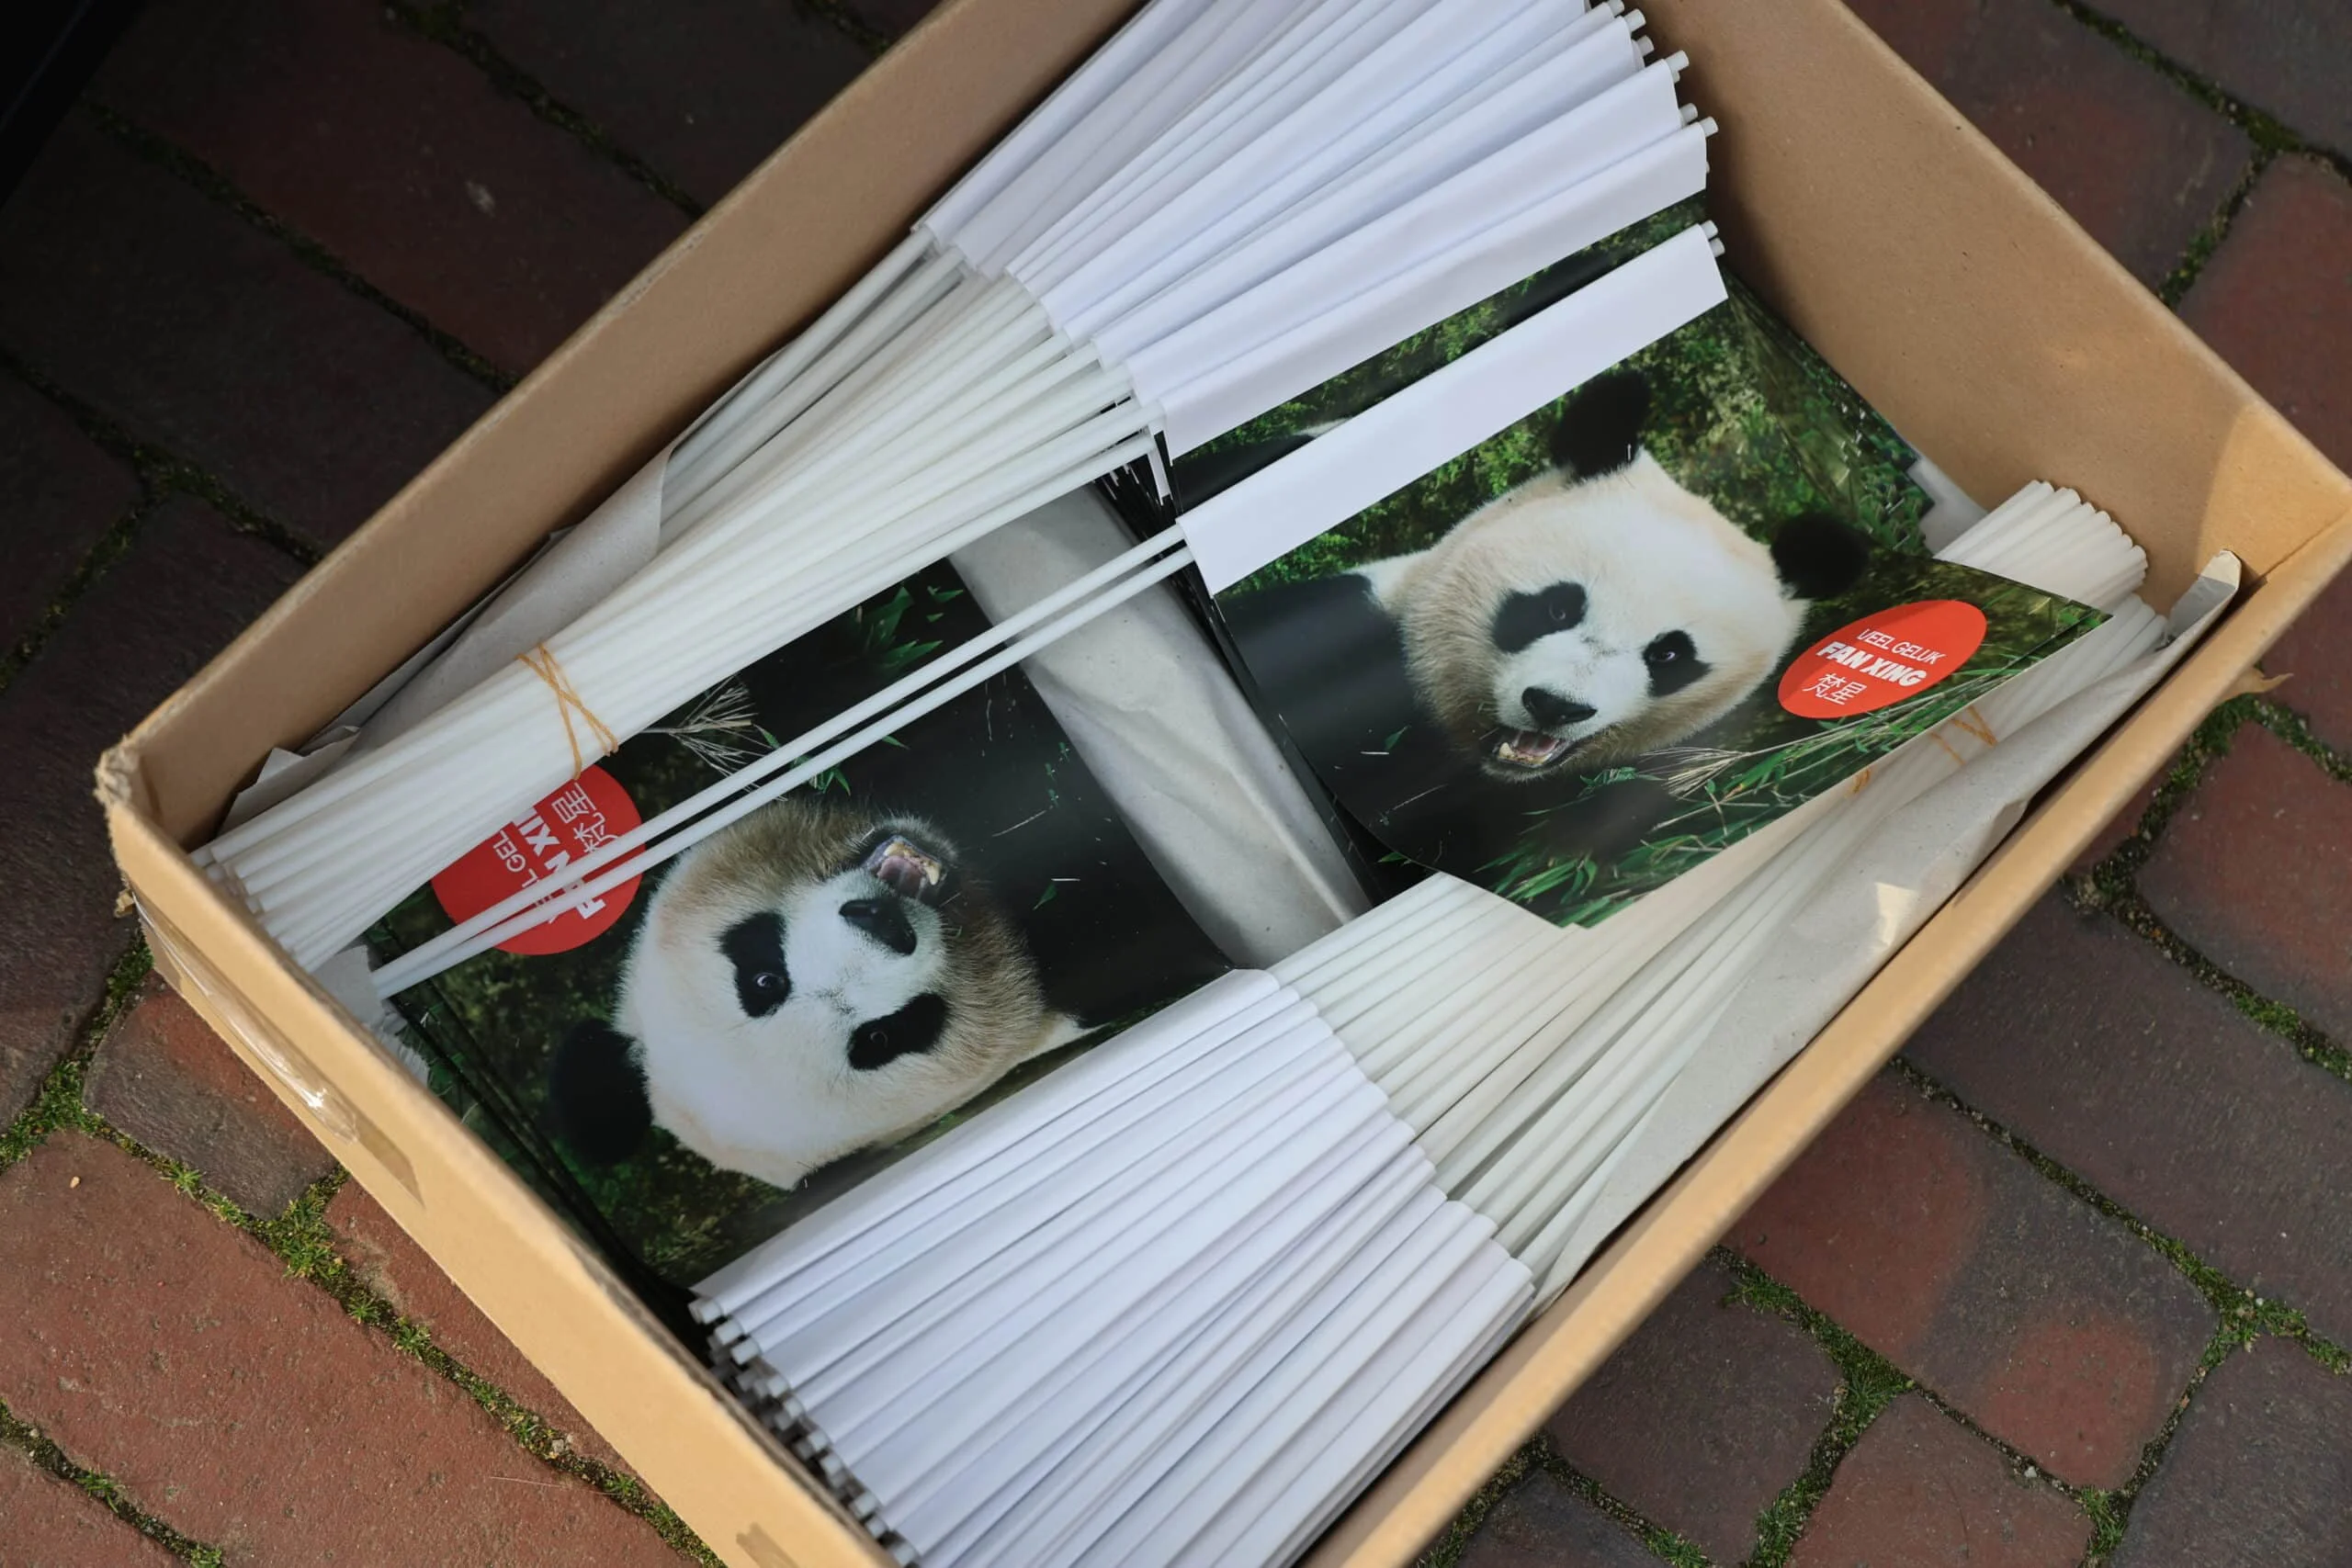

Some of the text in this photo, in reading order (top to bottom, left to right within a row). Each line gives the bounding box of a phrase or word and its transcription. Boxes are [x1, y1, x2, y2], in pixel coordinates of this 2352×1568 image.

[1816, 642, 1928, 686] FAN XING
[1857, 629, 1946, 664] VEEL GELUK
[1804, 673, 1867, 705] 梵星
